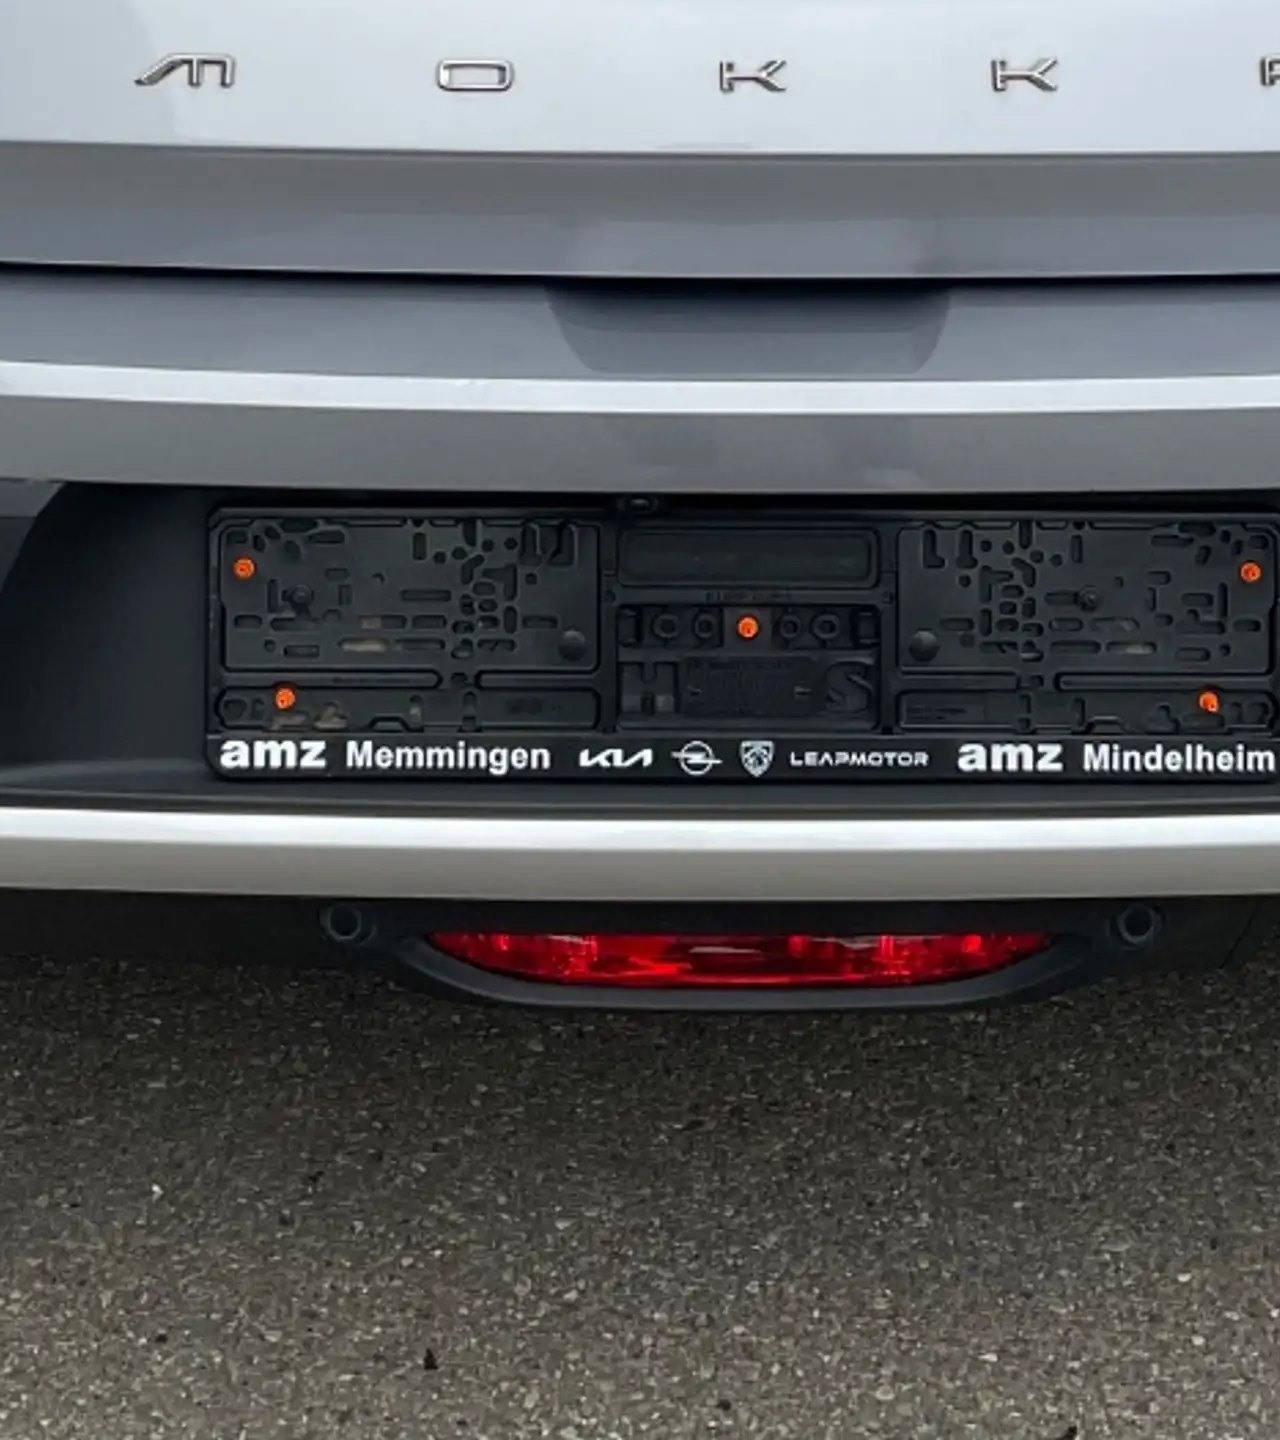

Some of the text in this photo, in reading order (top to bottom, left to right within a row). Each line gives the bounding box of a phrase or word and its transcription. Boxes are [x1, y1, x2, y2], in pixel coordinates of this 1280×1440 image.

[220, 739, 1277, 776] amz Memmingen KIA LEAPMOTOR amz Mindelheim
